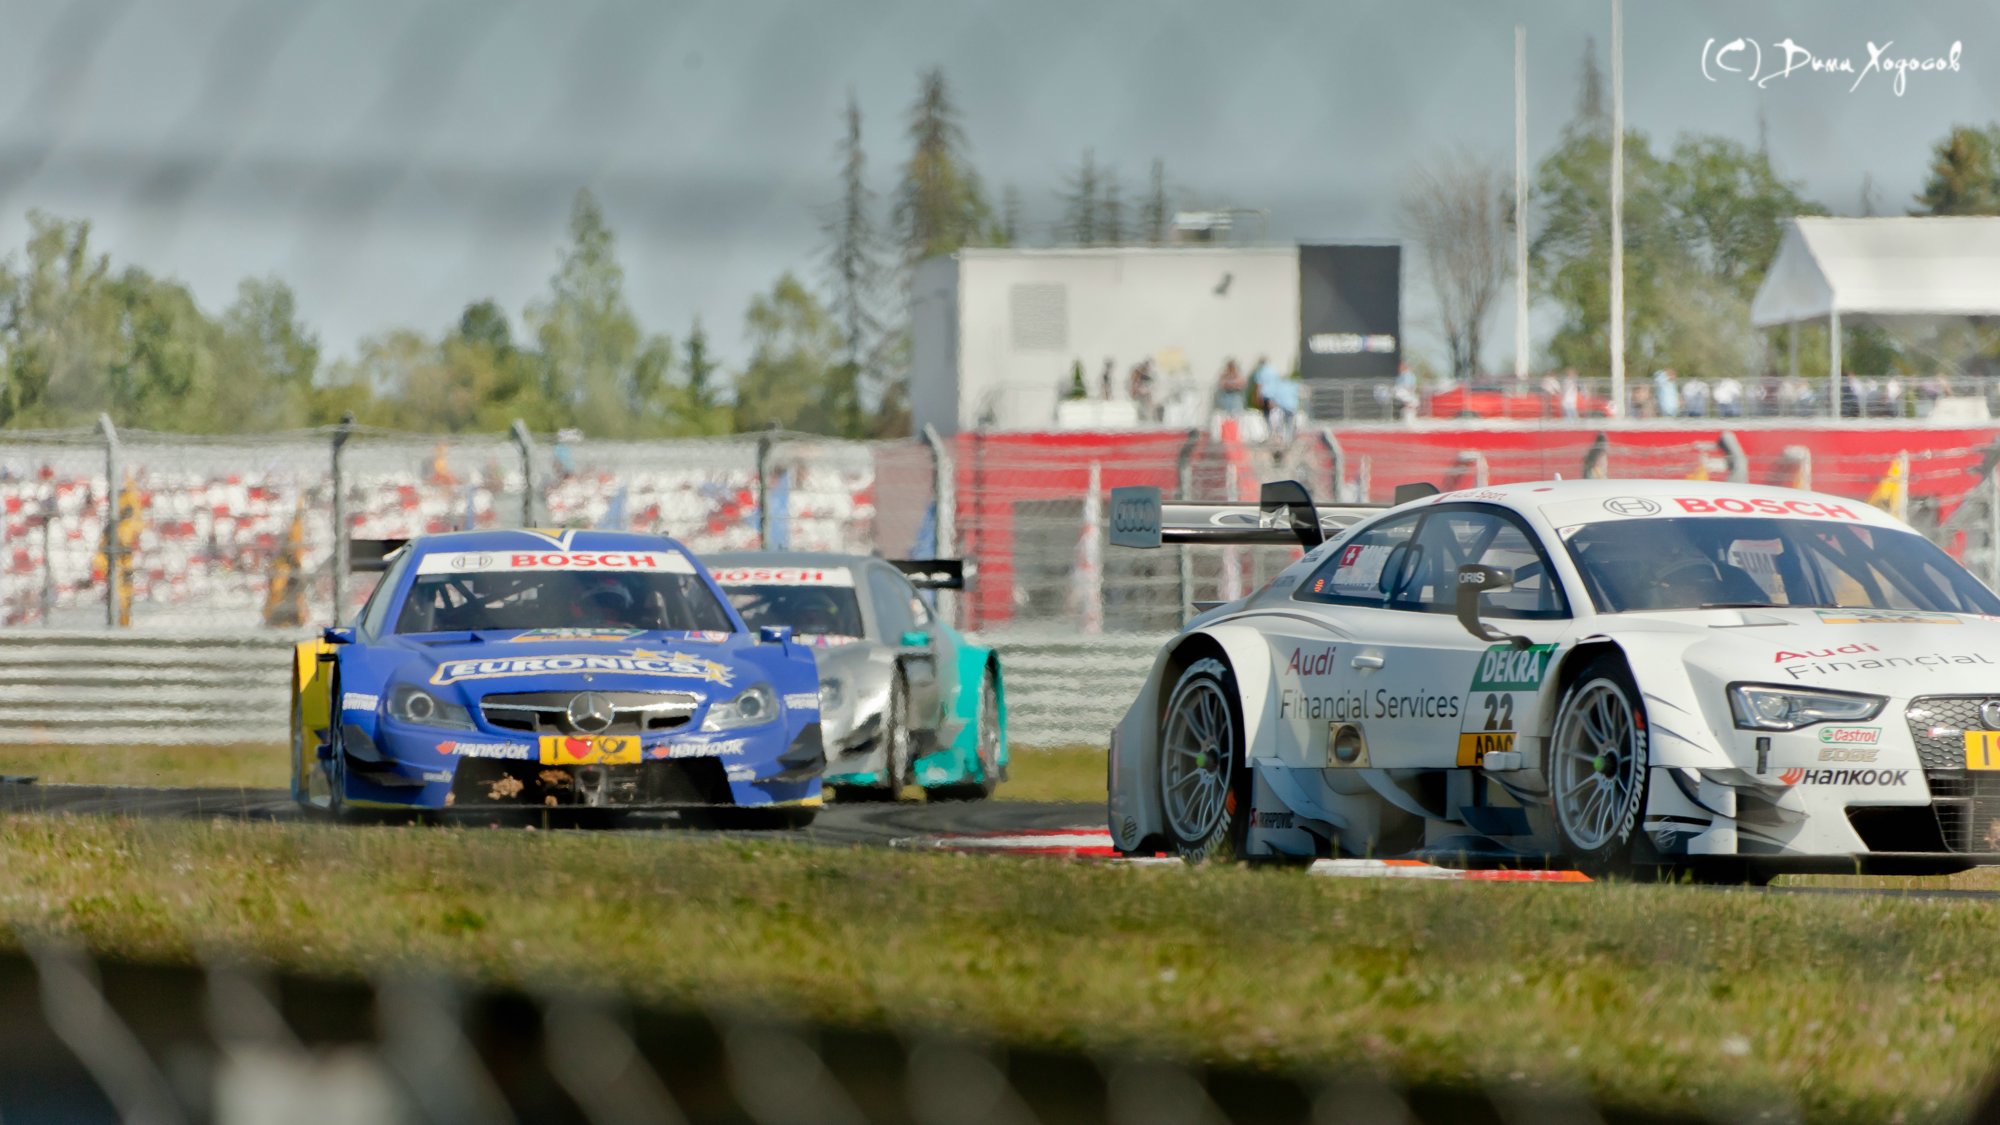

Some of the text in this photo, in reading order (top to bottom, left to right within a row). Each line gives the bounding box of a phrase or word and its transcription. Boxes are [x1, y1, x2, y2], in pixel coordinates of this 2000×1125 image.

[1673, 497, 1861, 520] BOSCH
[511, 554, 656, 568] BOSCH
[1285, 646, 1336, 676] Audi
[1774, 642, 1881, 663] Audi
[450, 657, 701, 678] EURONICS
[1481, 650, 1541, 683] DEKRA
[1374, 688, 1459, 719] Services
[1484, 692, 1514, 731] 22
[1834, 728, 1877, 743] Castrol
[1817, 748, 1881, 763] EDGE
